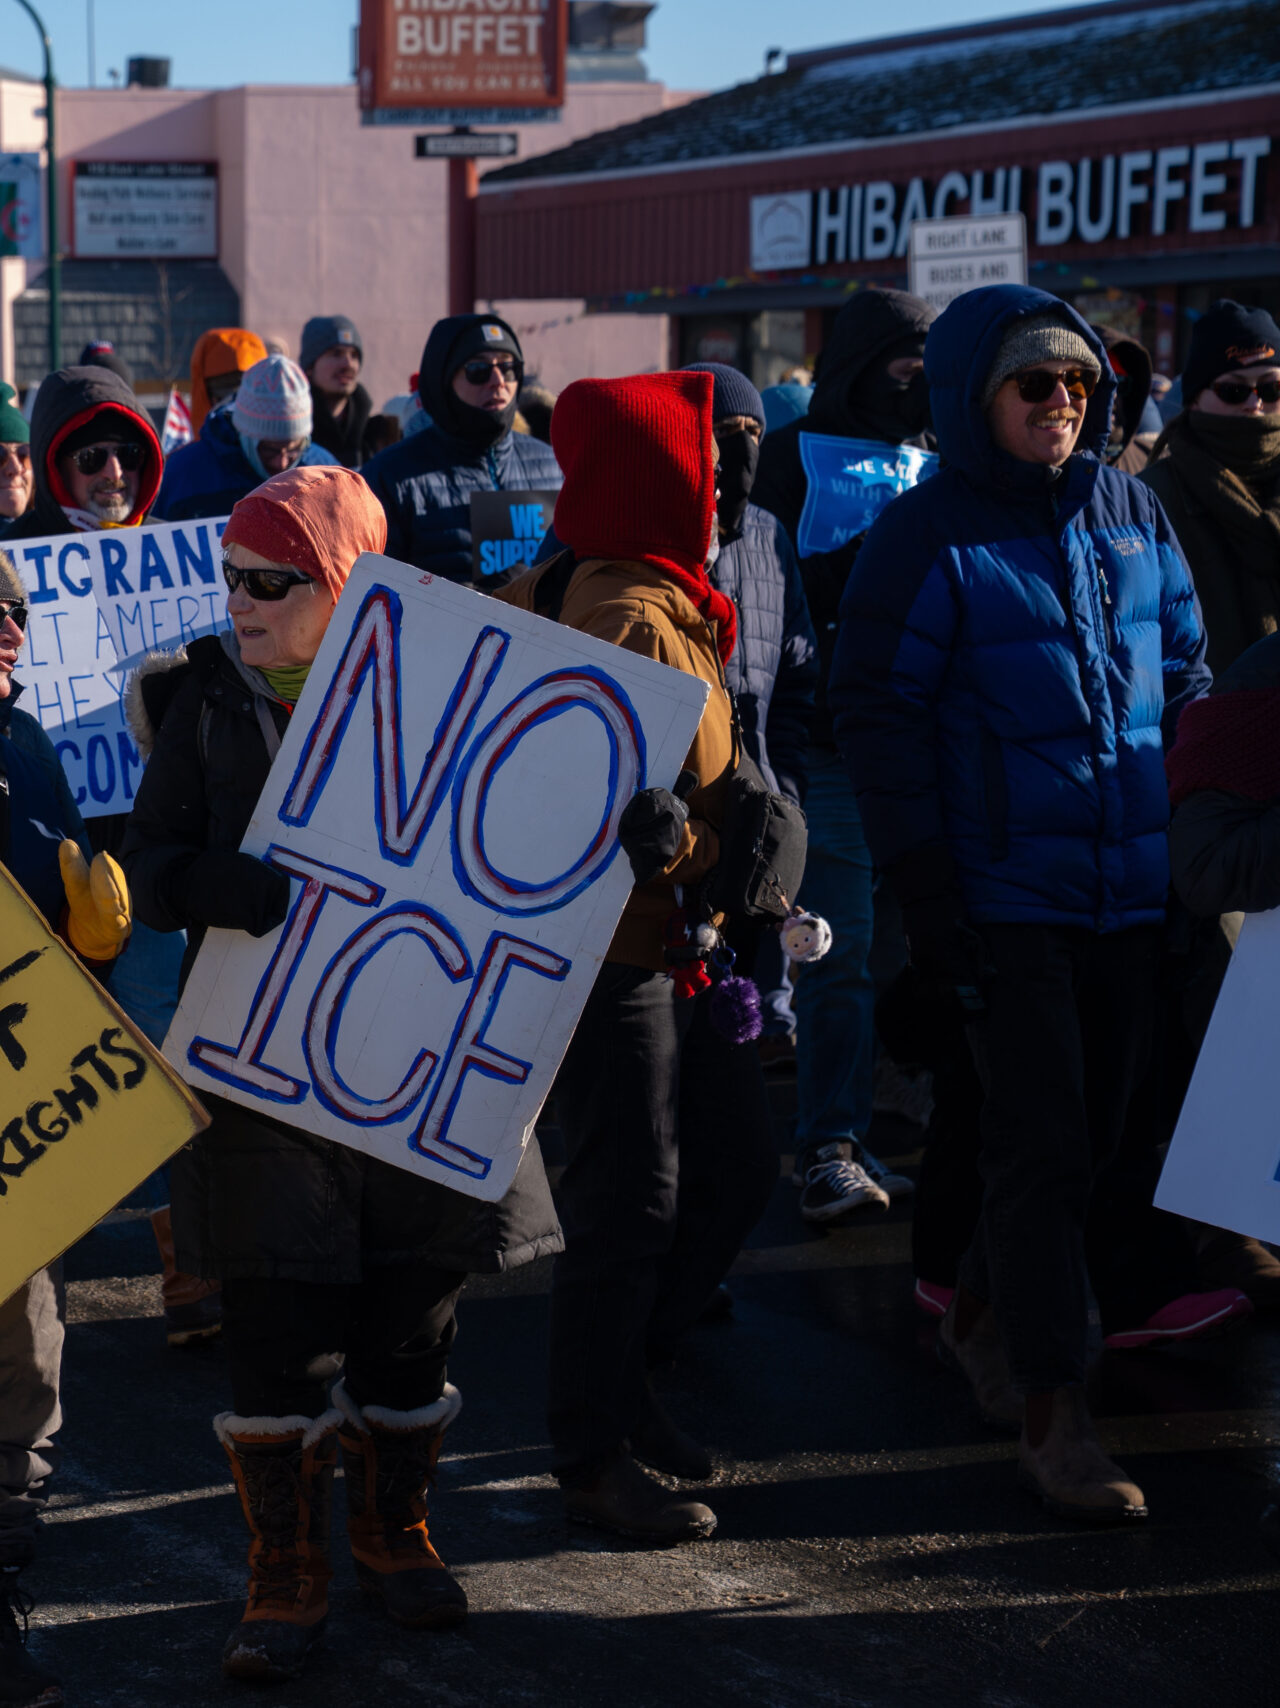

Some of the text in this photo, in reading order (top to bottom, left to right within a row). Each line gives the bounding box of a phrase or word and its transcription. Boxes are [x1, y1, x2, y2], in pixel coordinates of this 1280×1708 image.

[396, 15, 544, 55] BUFFET
[432, 75, 469, 90] YOU
[474, 75, 512, 90] CAN
[816, 135, 1271, 265] HIBACHI BUFFET
[926, 226, 1008, 249] RIGHT LANE
[928, 261, 1009, 284] BUSES AND
[831, 478, 881, 502] WITH
[509, 504, 546, 538] WE
[9, 522, 229, 604] IGRAN
[480, 539, 542, 576] SUPP
[14, 591, 234, 668] LT AMERI
[23, 670, 127, 732] HEY
[278, 583, 647, 919] NO
[188, 844, 572, 1180] ICE
